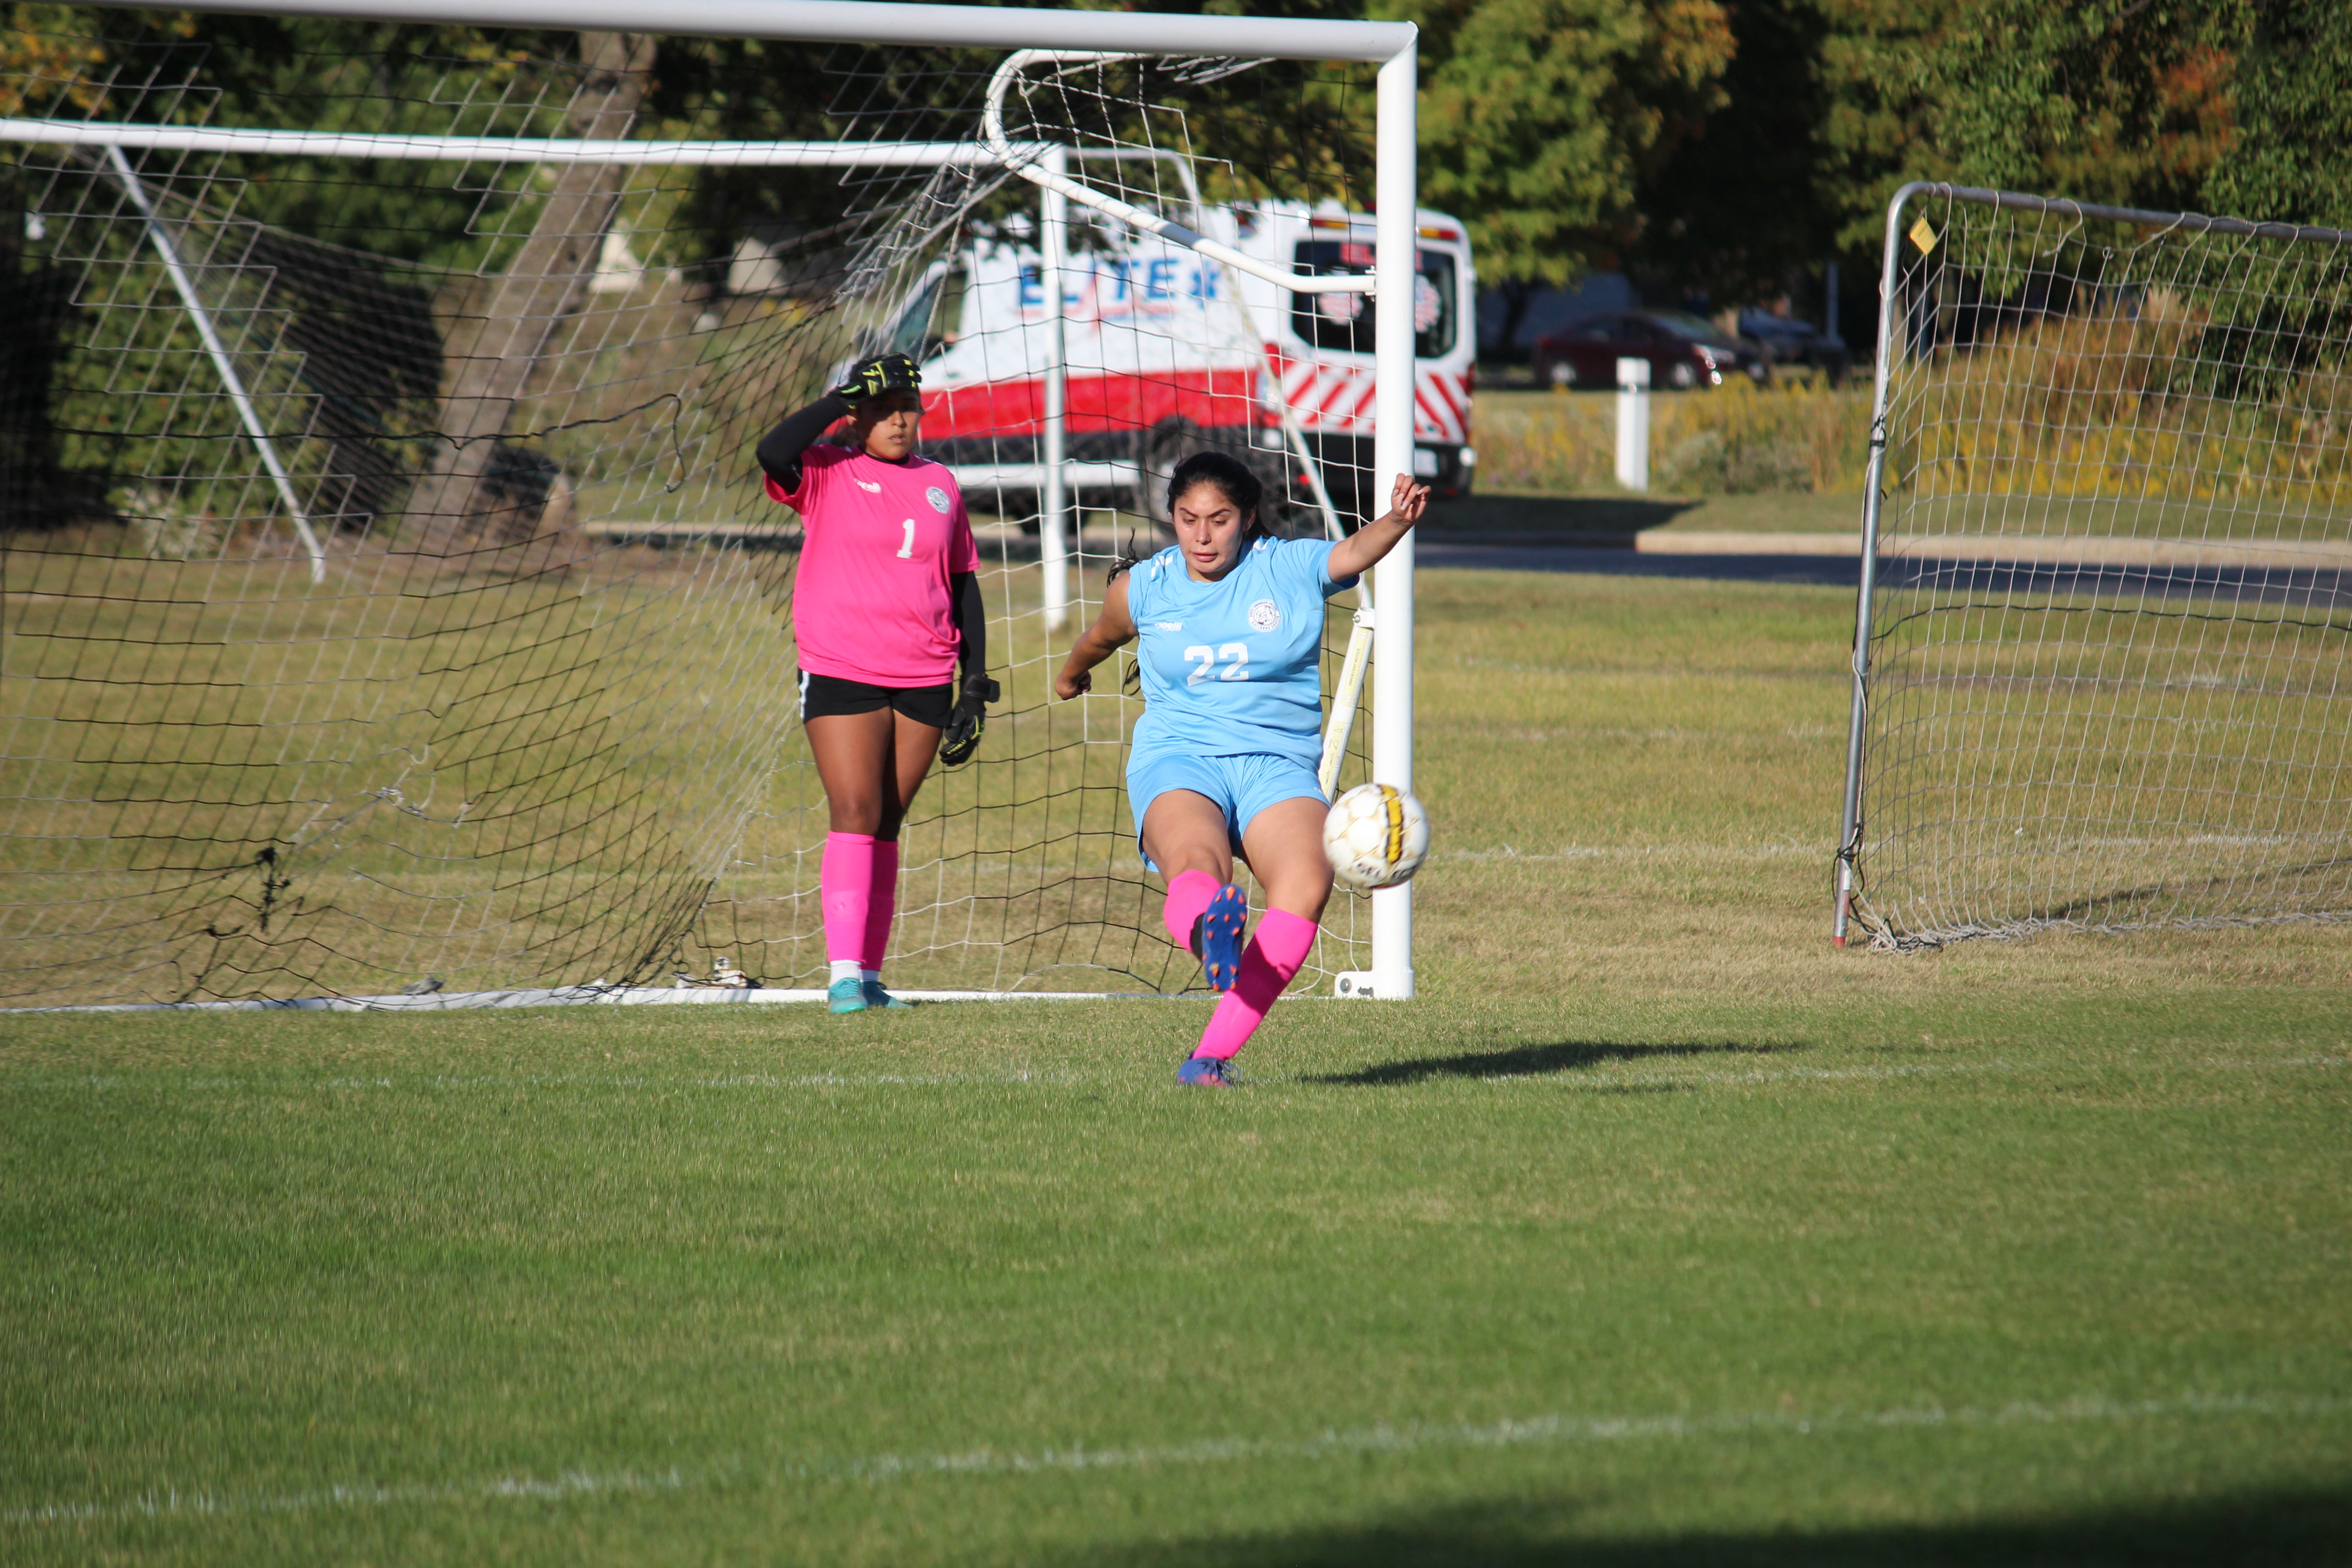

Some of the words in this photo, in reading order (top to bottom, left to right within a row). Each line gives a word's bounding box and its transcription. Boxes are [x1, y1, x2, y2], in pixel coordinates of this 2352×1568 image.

[897, 519, 915, 559] 1
[1184, 642, 1249, 686] 22
[1348, 663, 1357, 686] IMPORTANT
